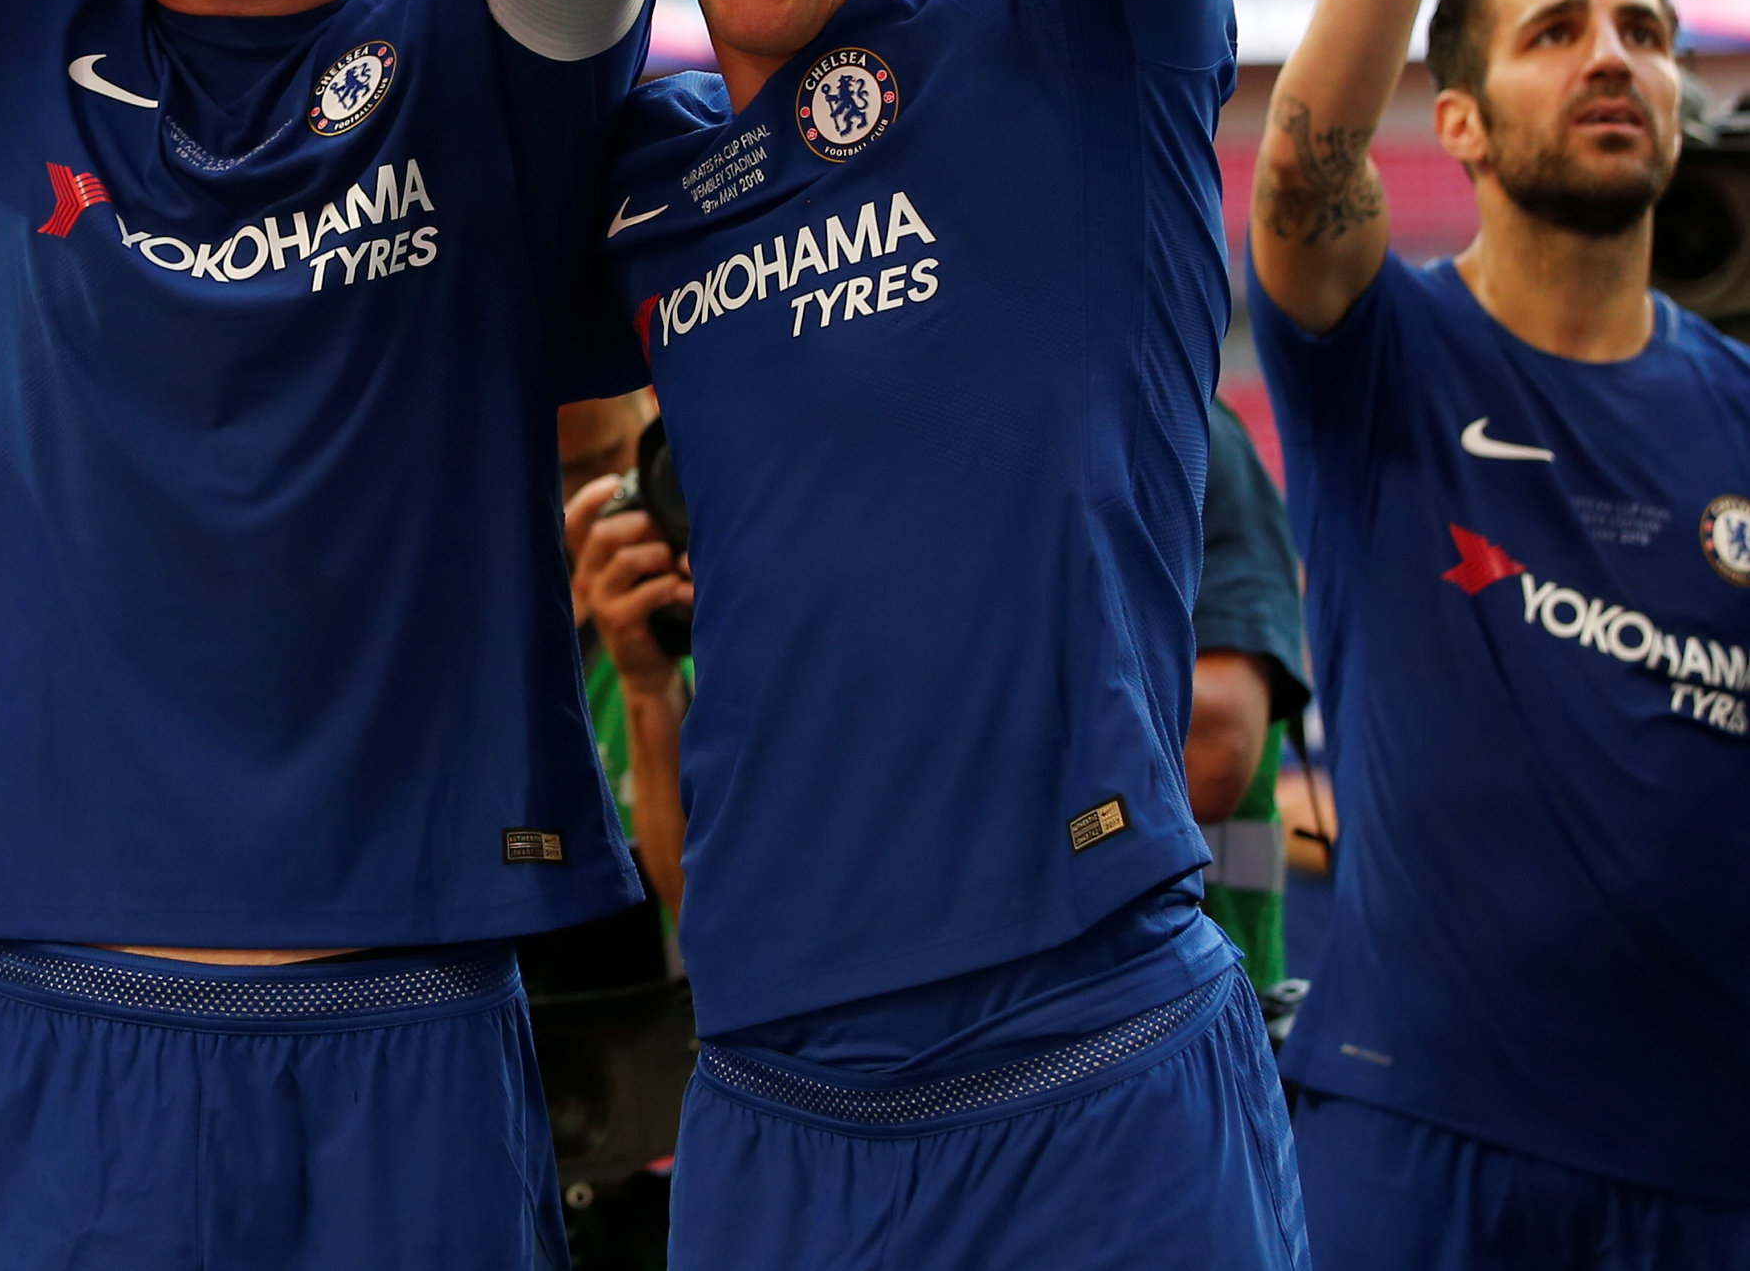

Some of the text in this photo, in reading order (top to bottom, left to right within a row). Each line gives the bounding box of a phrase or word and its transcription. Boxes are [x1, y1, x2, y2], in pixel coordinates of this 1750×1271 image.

[314, 45, 370, 96] CHELSEA
[804, 51, 868, 92] CHELSEA
[333, 77, 389, 131] FOOTBALL CLUB
[682, 124, 771, 190] EMIRATES FA CUP FINAL
[719, 182, 739, 205] MAY
[738, 168, 765, 193] 2018
[724, 145, 768, 181] STADIUM
[115, 158, 436, 283] YOKOHAMA
[308, 225, 439, 293] TYRES
[658, 191, 937, 347] YOKOHAMA
[790, 257, 940, 338] TYRES
